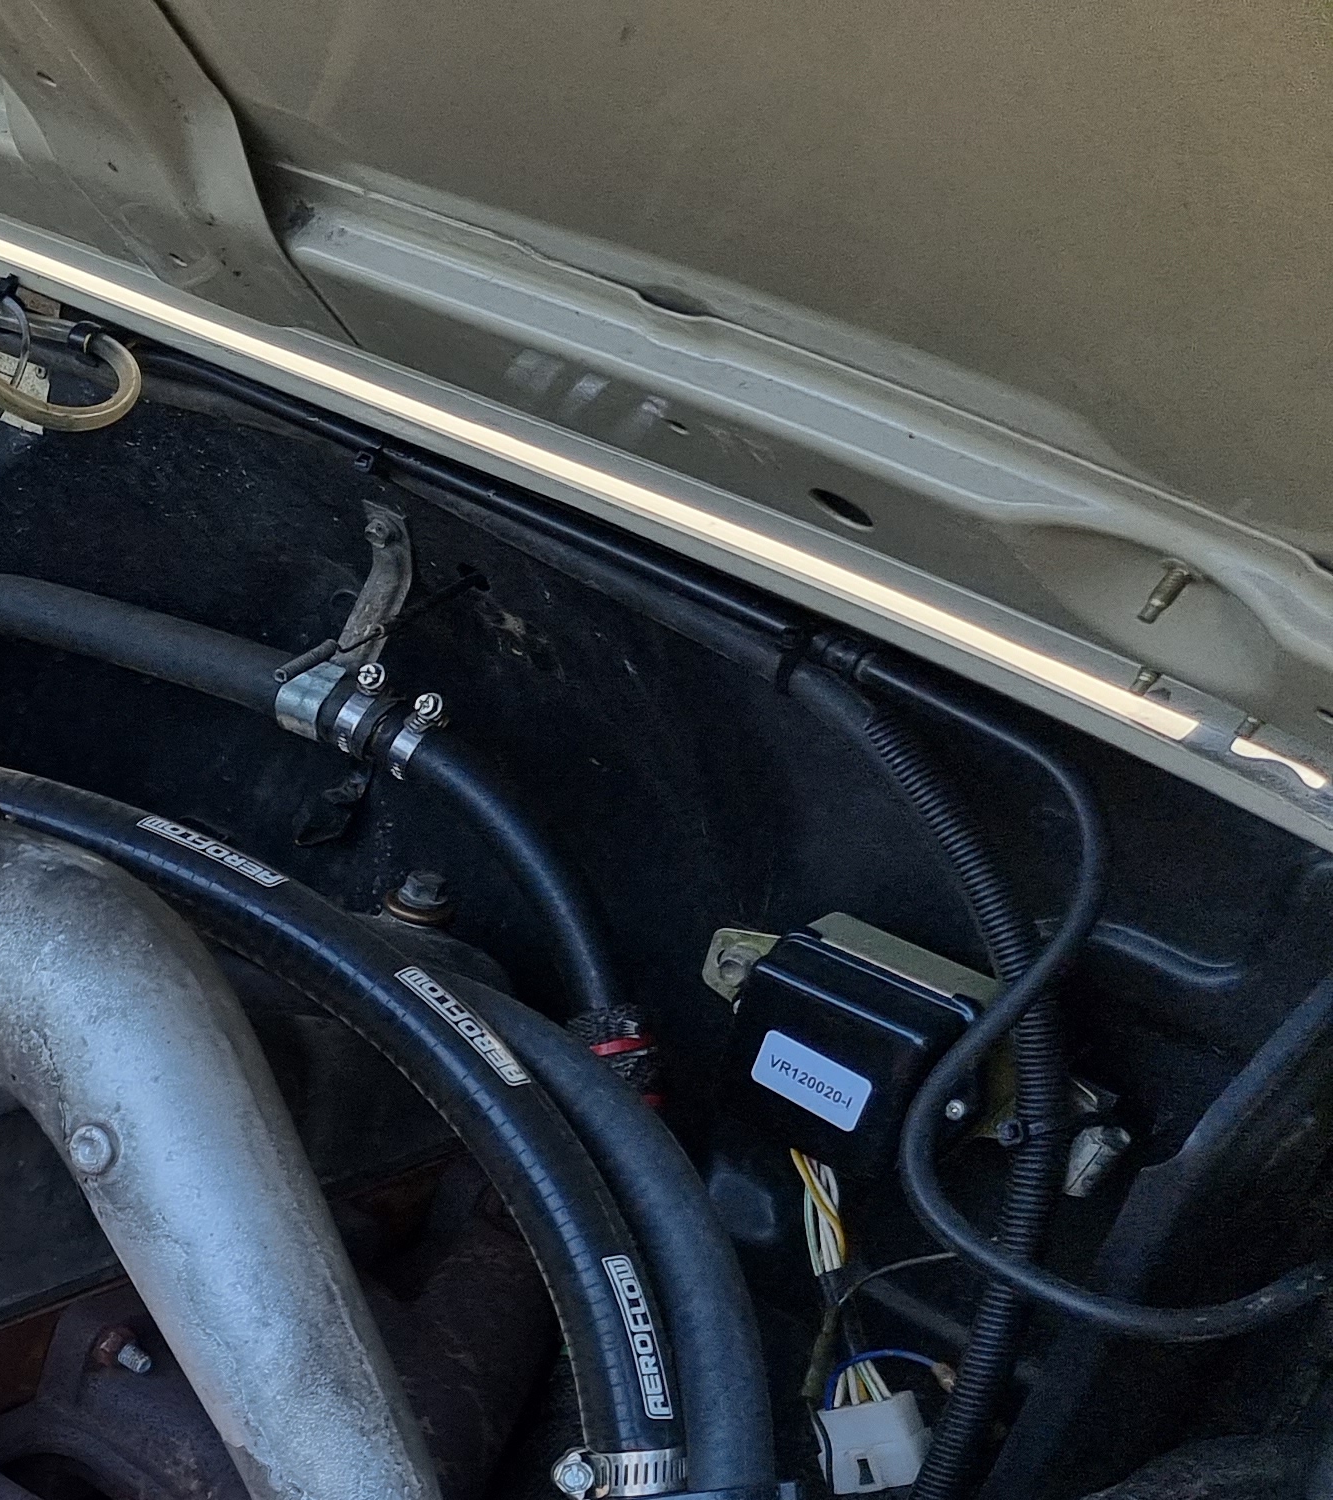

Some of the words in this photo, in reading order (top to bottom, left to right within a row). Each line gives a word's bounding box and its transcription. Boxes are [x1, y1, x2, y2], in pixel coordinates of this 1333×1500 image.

[140, 816, 283, 886] AEROFLOW
[399, 968, 527, 1085] AEROFLOW
[606, 1257, 671, 1418] AEROFLOW
